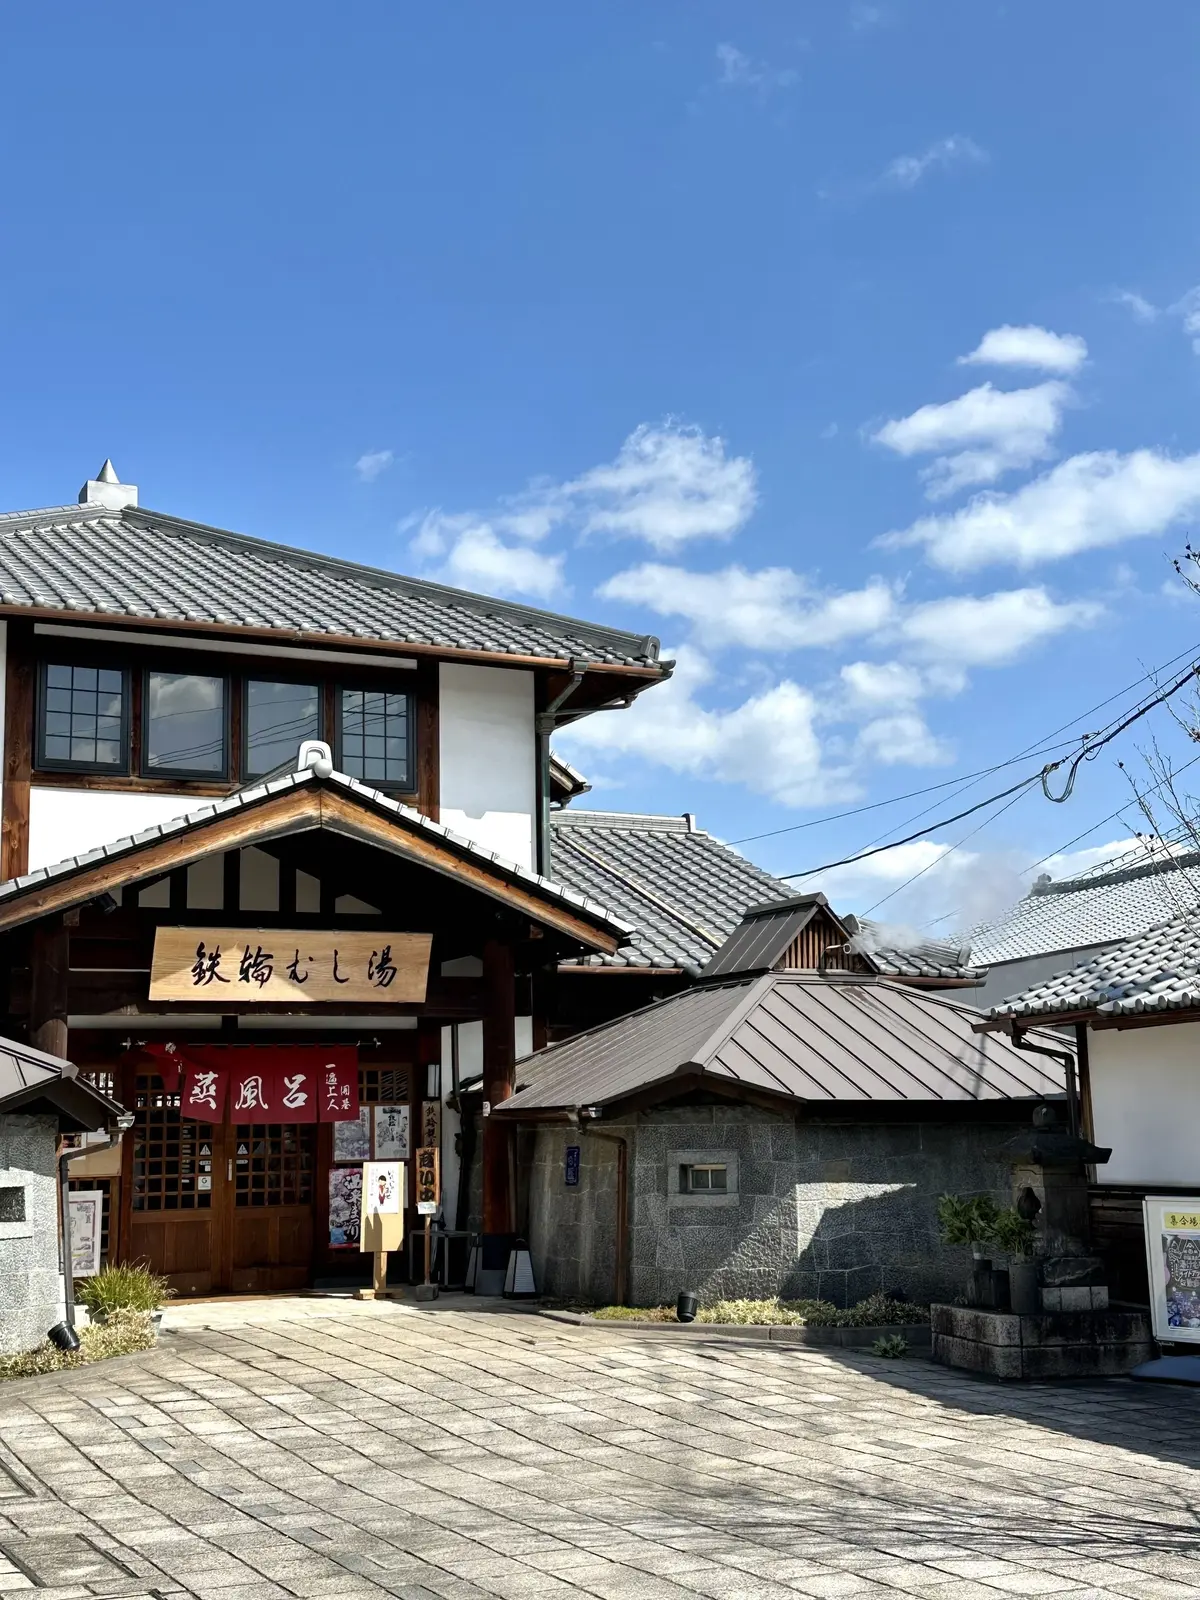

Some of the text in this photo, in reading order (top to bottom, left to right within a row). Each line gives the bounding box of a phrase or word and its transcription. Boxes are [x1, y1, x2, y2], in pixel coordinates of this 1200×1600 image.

[190, 941, 398, 989] 鉄輪むし湯
[189, 1070, 309, 1110] 蒸風呂
[325, 1063, 339, 1111] 一遍上人
[1170, 1214, 1200, 1227] 集合場
